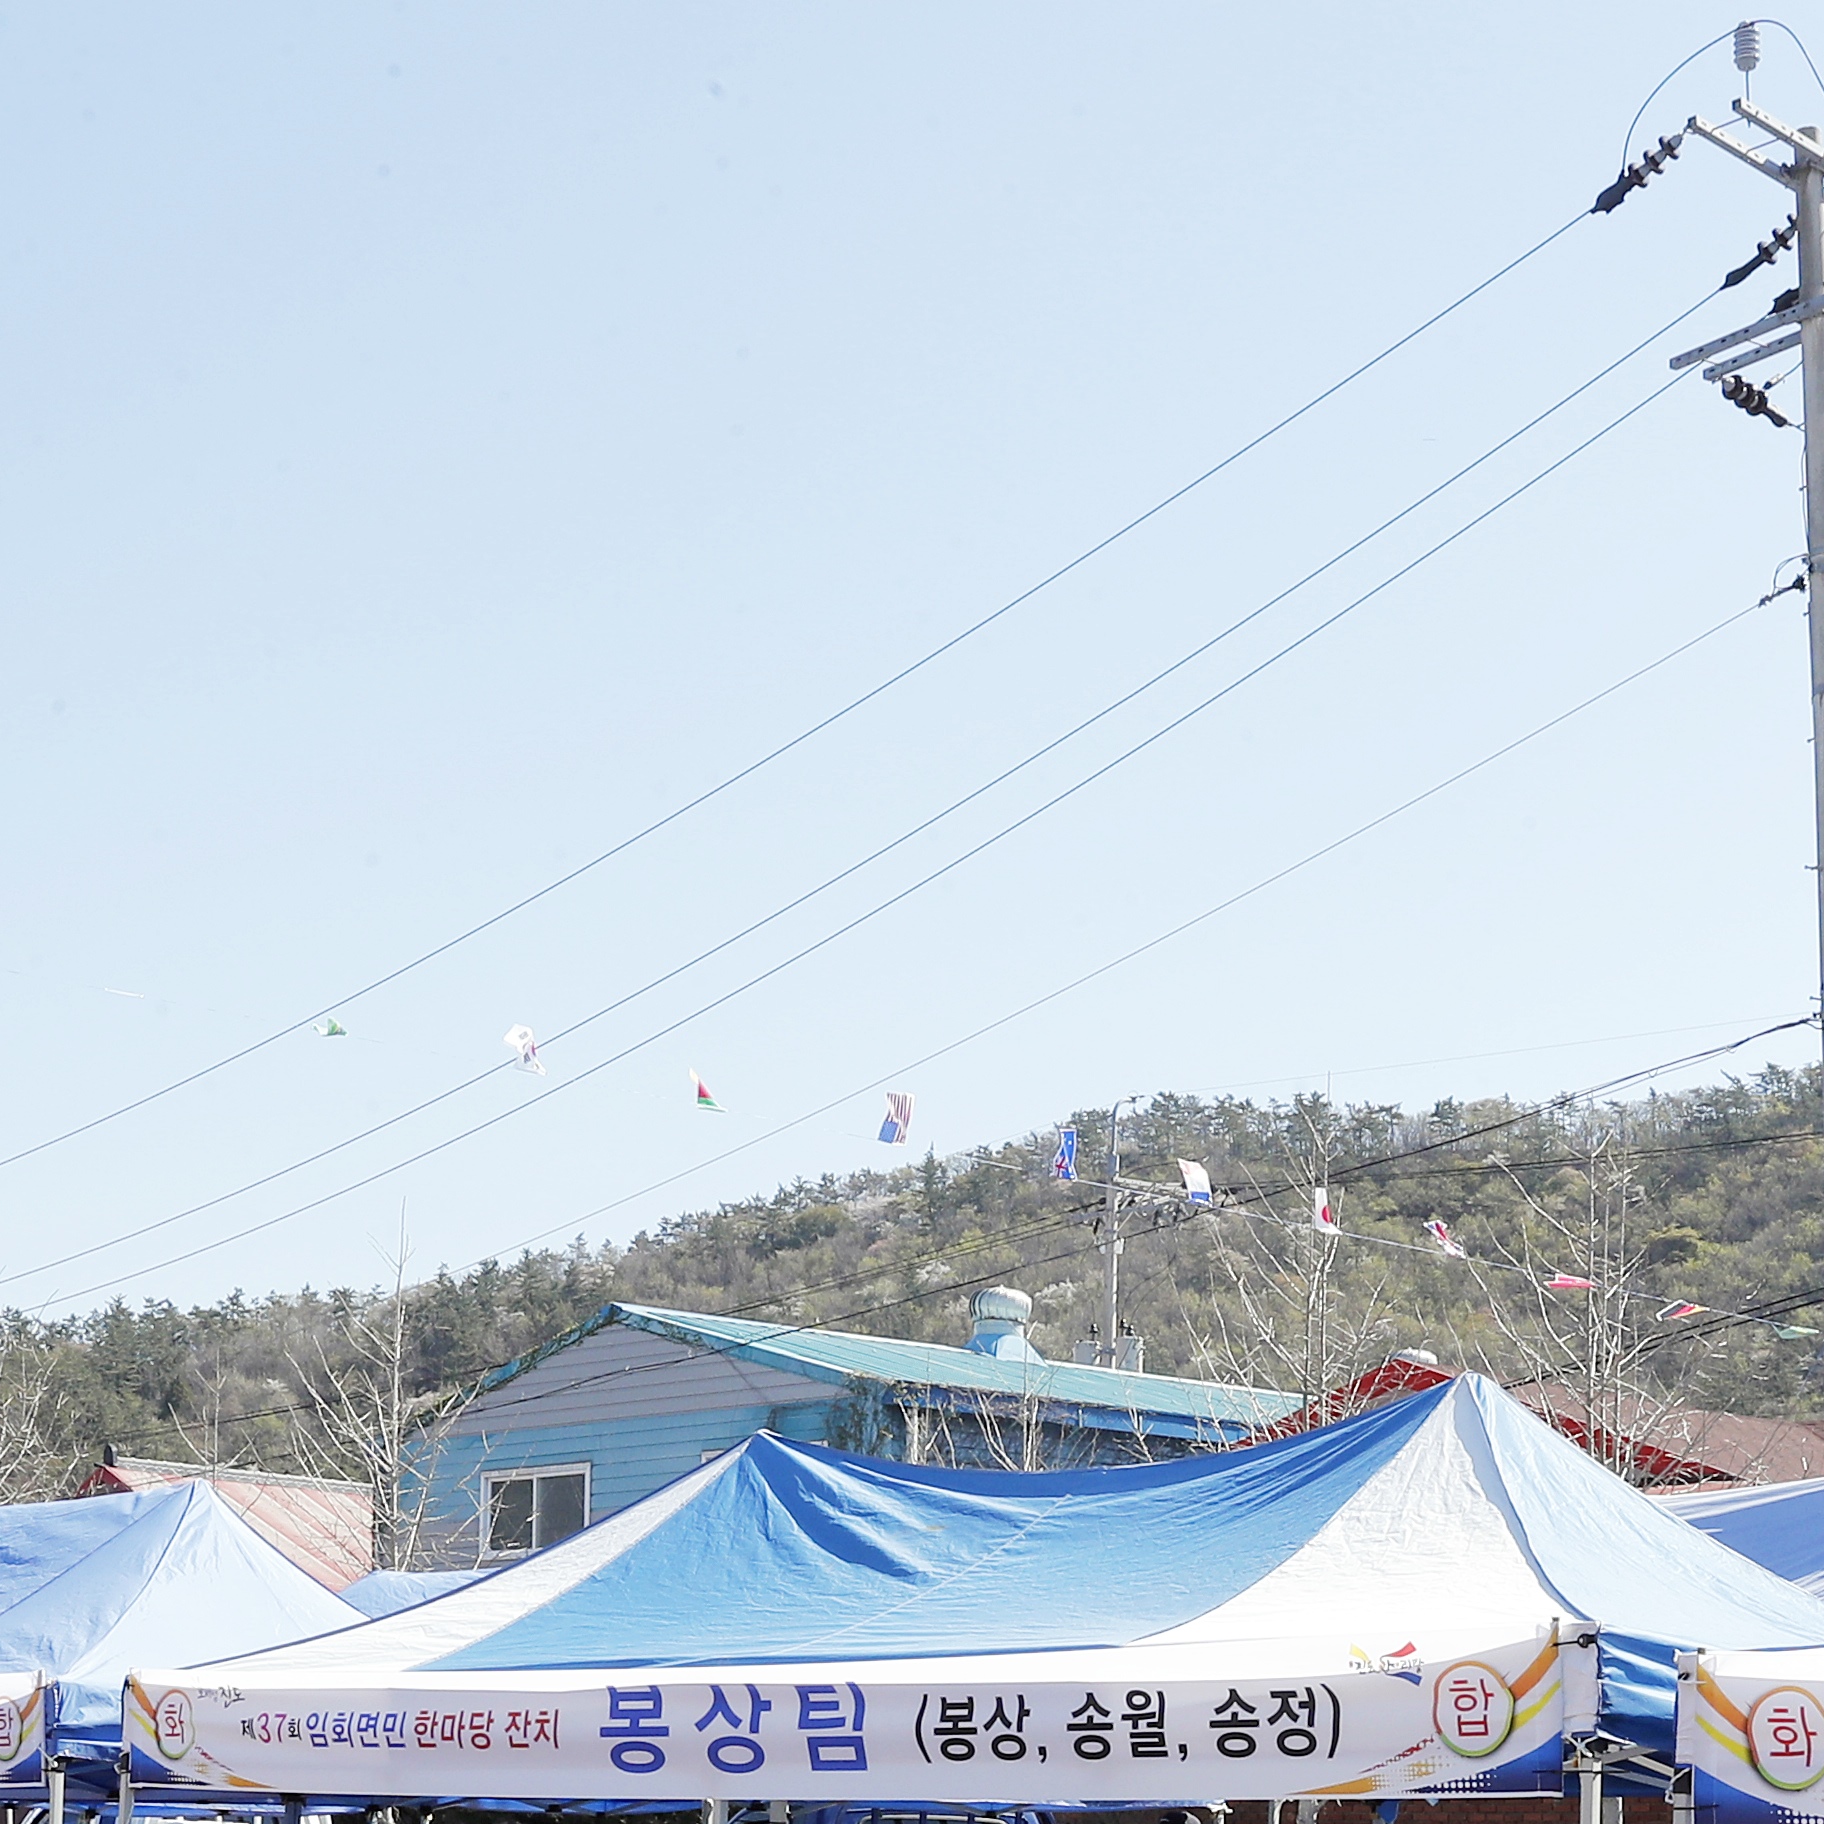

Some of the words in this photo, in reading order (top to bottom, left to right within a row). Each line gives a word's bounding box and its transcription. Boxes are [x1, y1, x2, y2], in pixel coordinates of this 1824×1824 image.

[240, 1712, 302, 1743] 제37회
[305, 1710, 407, 1749] 임회면민
[414, 1709, 495, 1750] 한마당
[502, 1708, 560, 1750] 잔치
[599, 1681, 869, 1775] 봉상팀
[914, 1694, 1048, 1765] (봉상,
[1066, 1687, 1188, 1763] 송월,
[1208, 1682, 1341, 1760] 송정)
